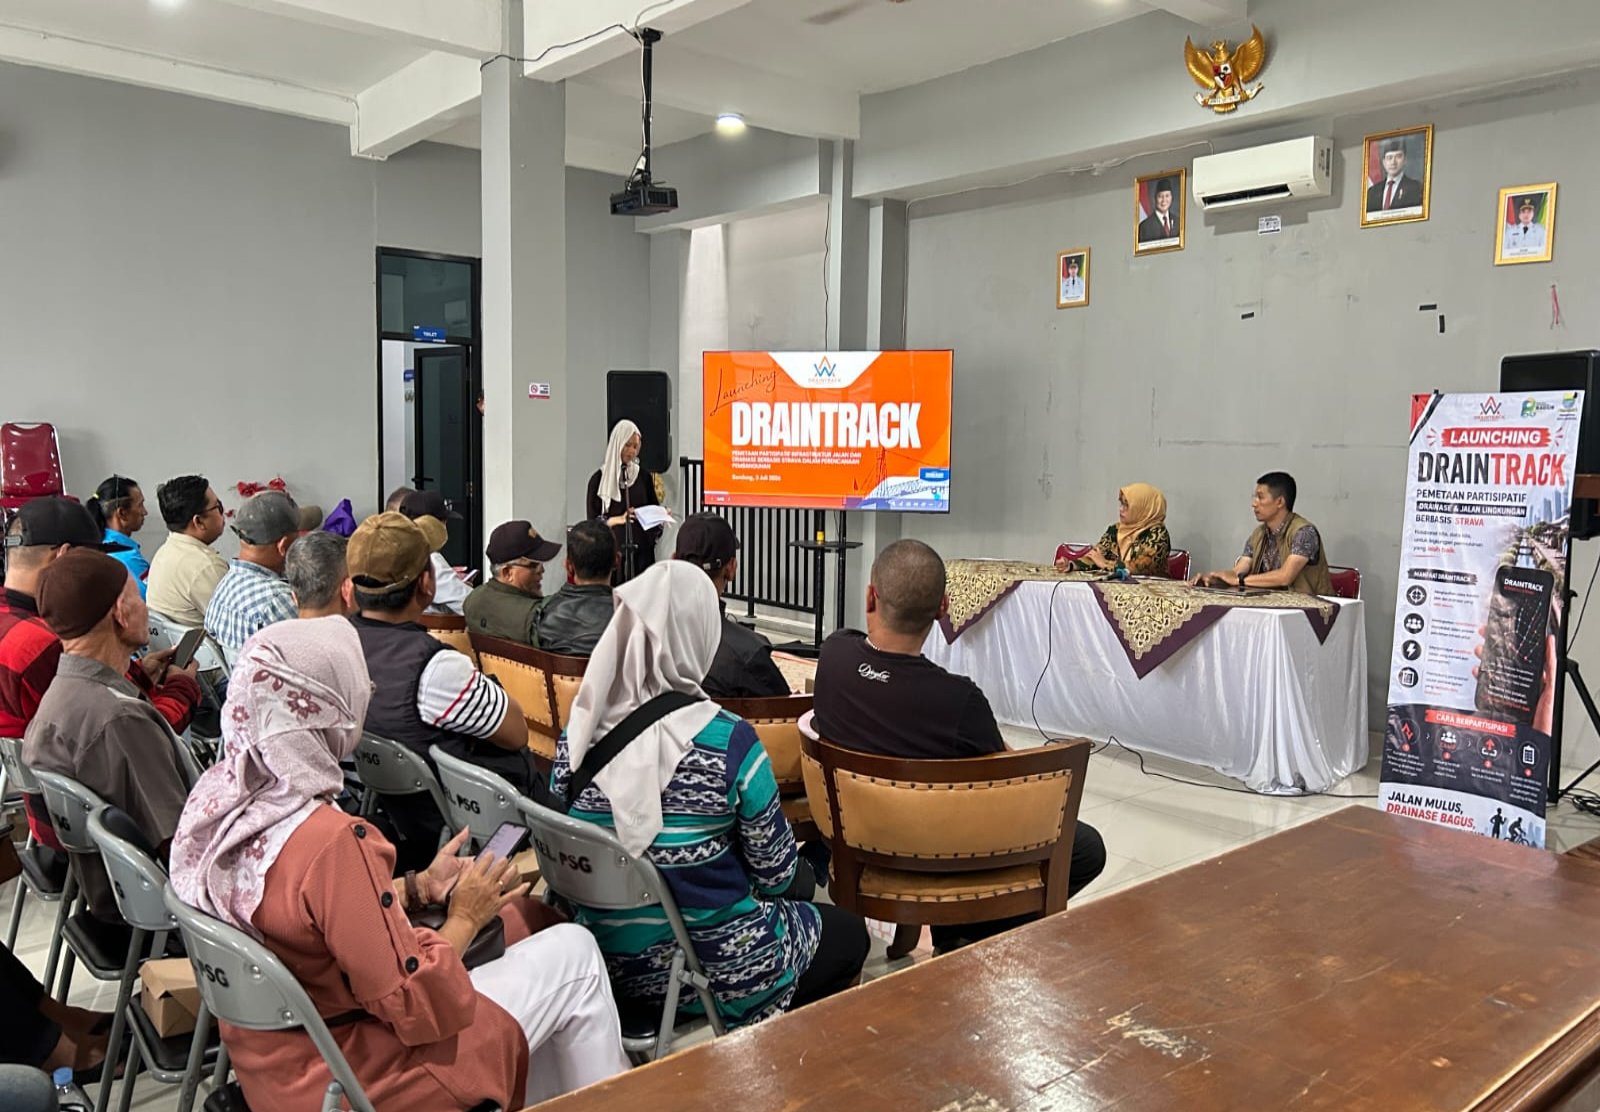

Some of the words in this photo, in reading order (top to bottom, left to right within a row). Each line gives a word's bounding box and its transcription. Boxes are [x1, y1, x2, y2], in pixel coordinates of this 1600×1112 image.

[709, 368, 778, 416] Launching
[731, 402, 922, 449] DRAINTRACK
[1450, 430, 1541, 444] LAUNCHING
[1417, 451, 1567, 486] DRAINTRACK
[1416, 489, 1465, 500] PEMETAAN
[1467, 491, 1527, 503] PARTISIPATIF
[1419, 502, 1452, 512] DRAINASE
[1460, 505, 1480, 513] JALAN
[1482, 506, 1525, 515] LINGKUNGAN
[1415, 514, 1452, 524] BERBASIS
[1455, 517, 1484, 526] STRAVA
[1413, 570, 1438, 579] MANFAAT
[1438, 573, 1471, 582] DRAINTRACK
[1503, 578, 1543, 592] DRAINTRACK
[1436, 712, 1454, 723] CARA
[1456, 715, 1508, 732] BERPARTISIPASI
[456, 793, 480, 814] PSG
[1387, 791, 1422, 806] JALAN
[1424, 798, 1464, 815] MULUS,
[1386, 802, 1438, 821] DRAINASE
[1440, 813, 1476, 829] BAGUS,
[558, 851, 592, 873] PSG
